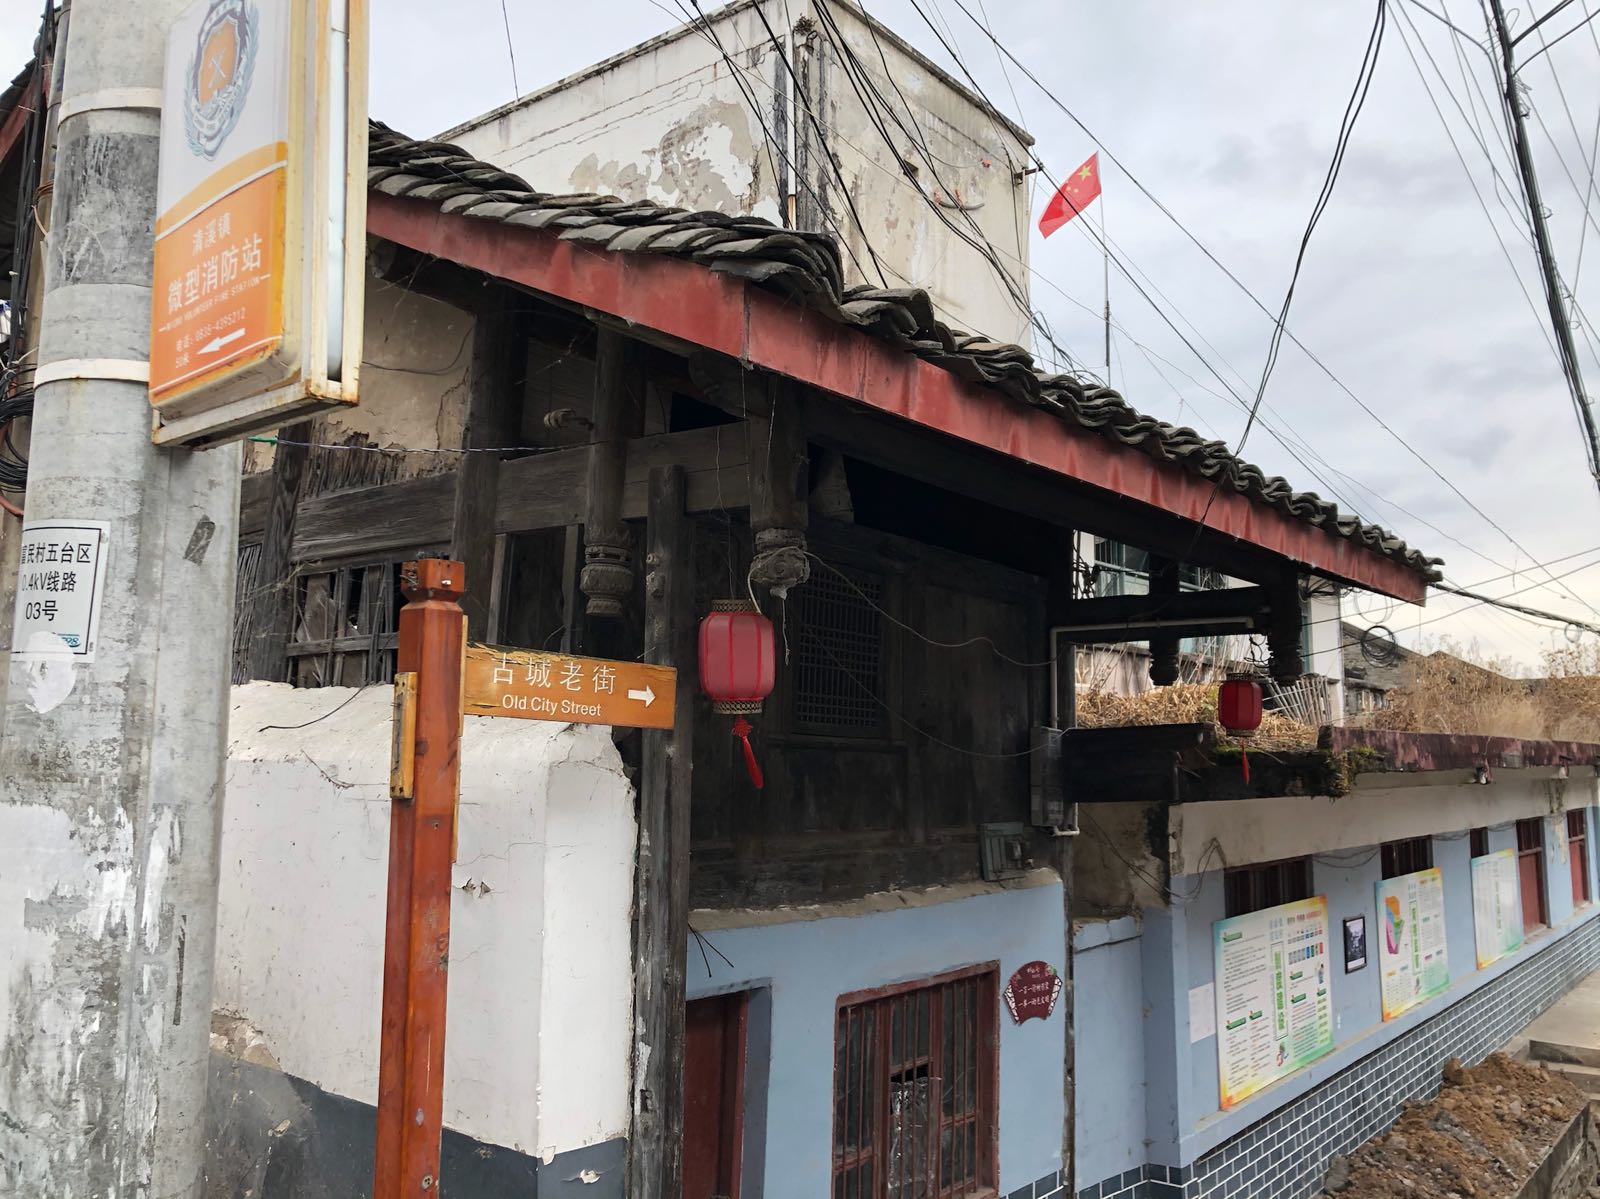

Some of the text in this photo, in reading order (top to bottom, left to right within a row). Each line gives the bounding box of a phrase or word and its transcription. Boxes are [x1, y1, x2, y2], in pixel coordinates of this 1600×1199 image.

[168, 234, 262, 313] 微型消防站
[232, 276, 260, 295] STATION
[25, 600, 58, 621] 03号
[493, 652, 616, 695] 古城老街
[502, 694, 602, 717] Old City Street
